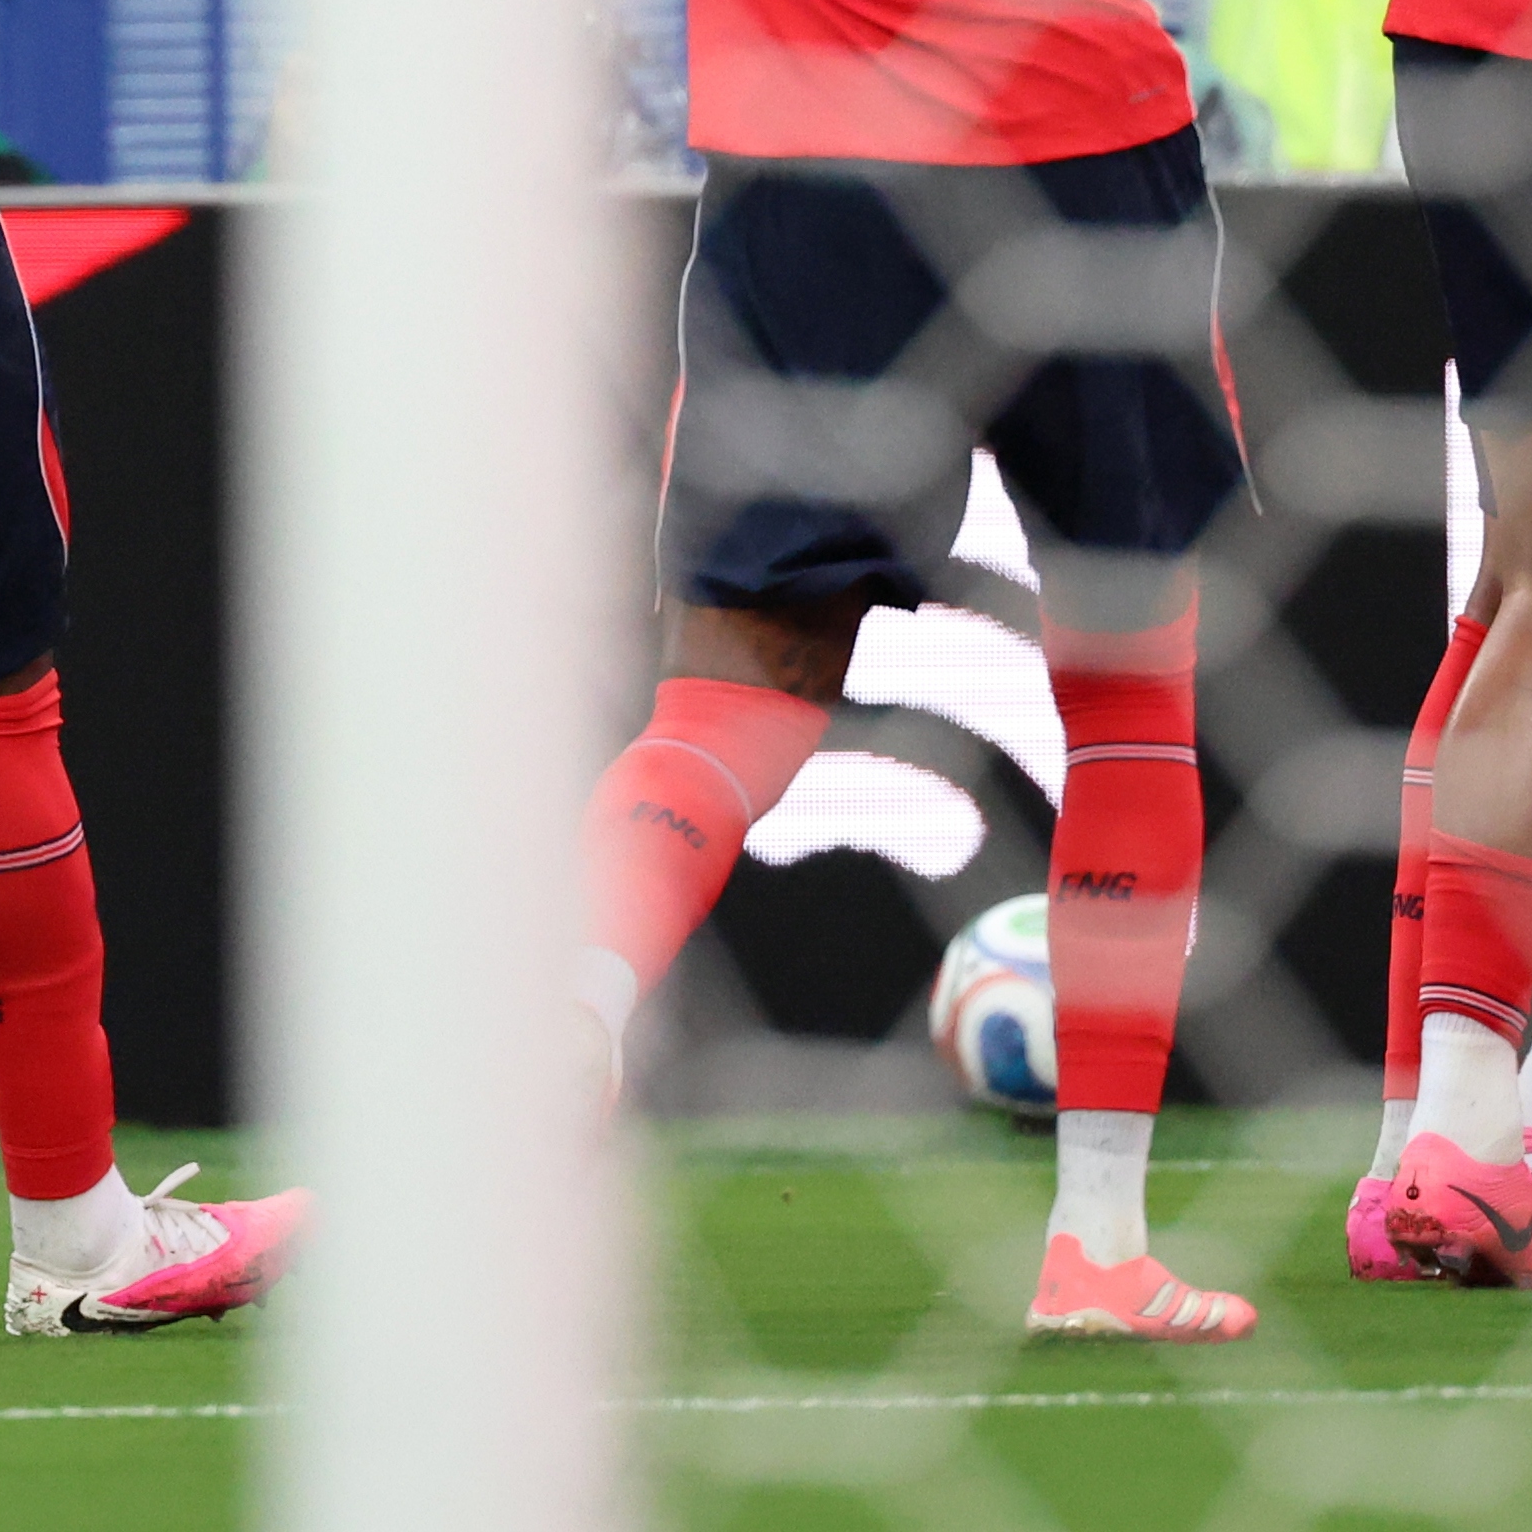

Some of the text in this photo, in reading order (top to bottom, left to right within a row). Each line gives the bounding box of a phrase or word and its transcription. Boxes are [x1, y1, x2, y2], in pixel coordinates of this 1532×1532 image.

[631, 800, 708, 849] ENG
[1056, 872, 1137, 902] ENG
[1393, 893, 1425, 921] NG
